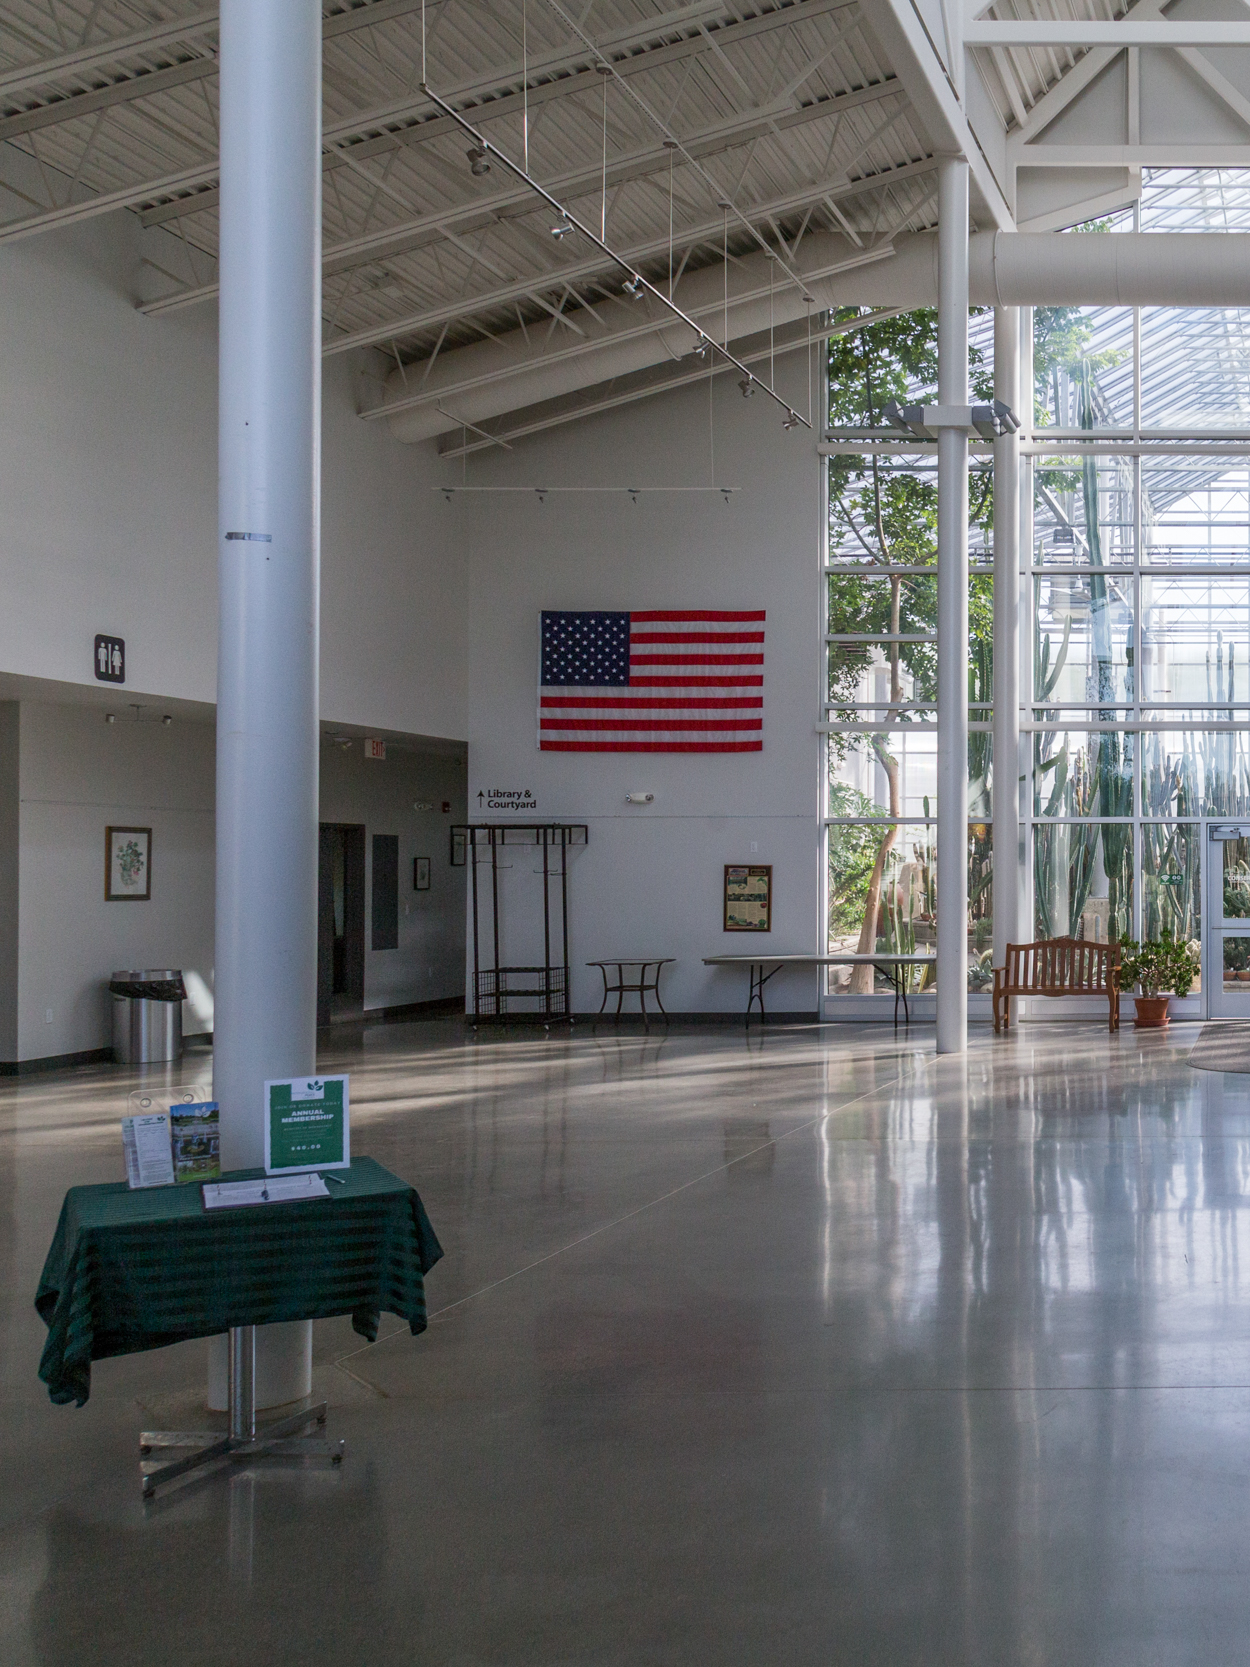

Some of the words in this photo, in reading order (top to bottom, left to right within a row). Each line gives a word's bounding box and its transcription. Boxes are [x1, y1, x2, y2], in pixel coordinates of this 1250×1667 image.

[372, 740, 383, 757] EXIT
[488, 789, 522, 800] Library
[524, 790, 532, 798] &
[488, 800, 536, 811] Courtyard
[281, 1114, 334, 1123] MEMBERSHIP
[292, 1109, 324, 1117] ANNUAL
